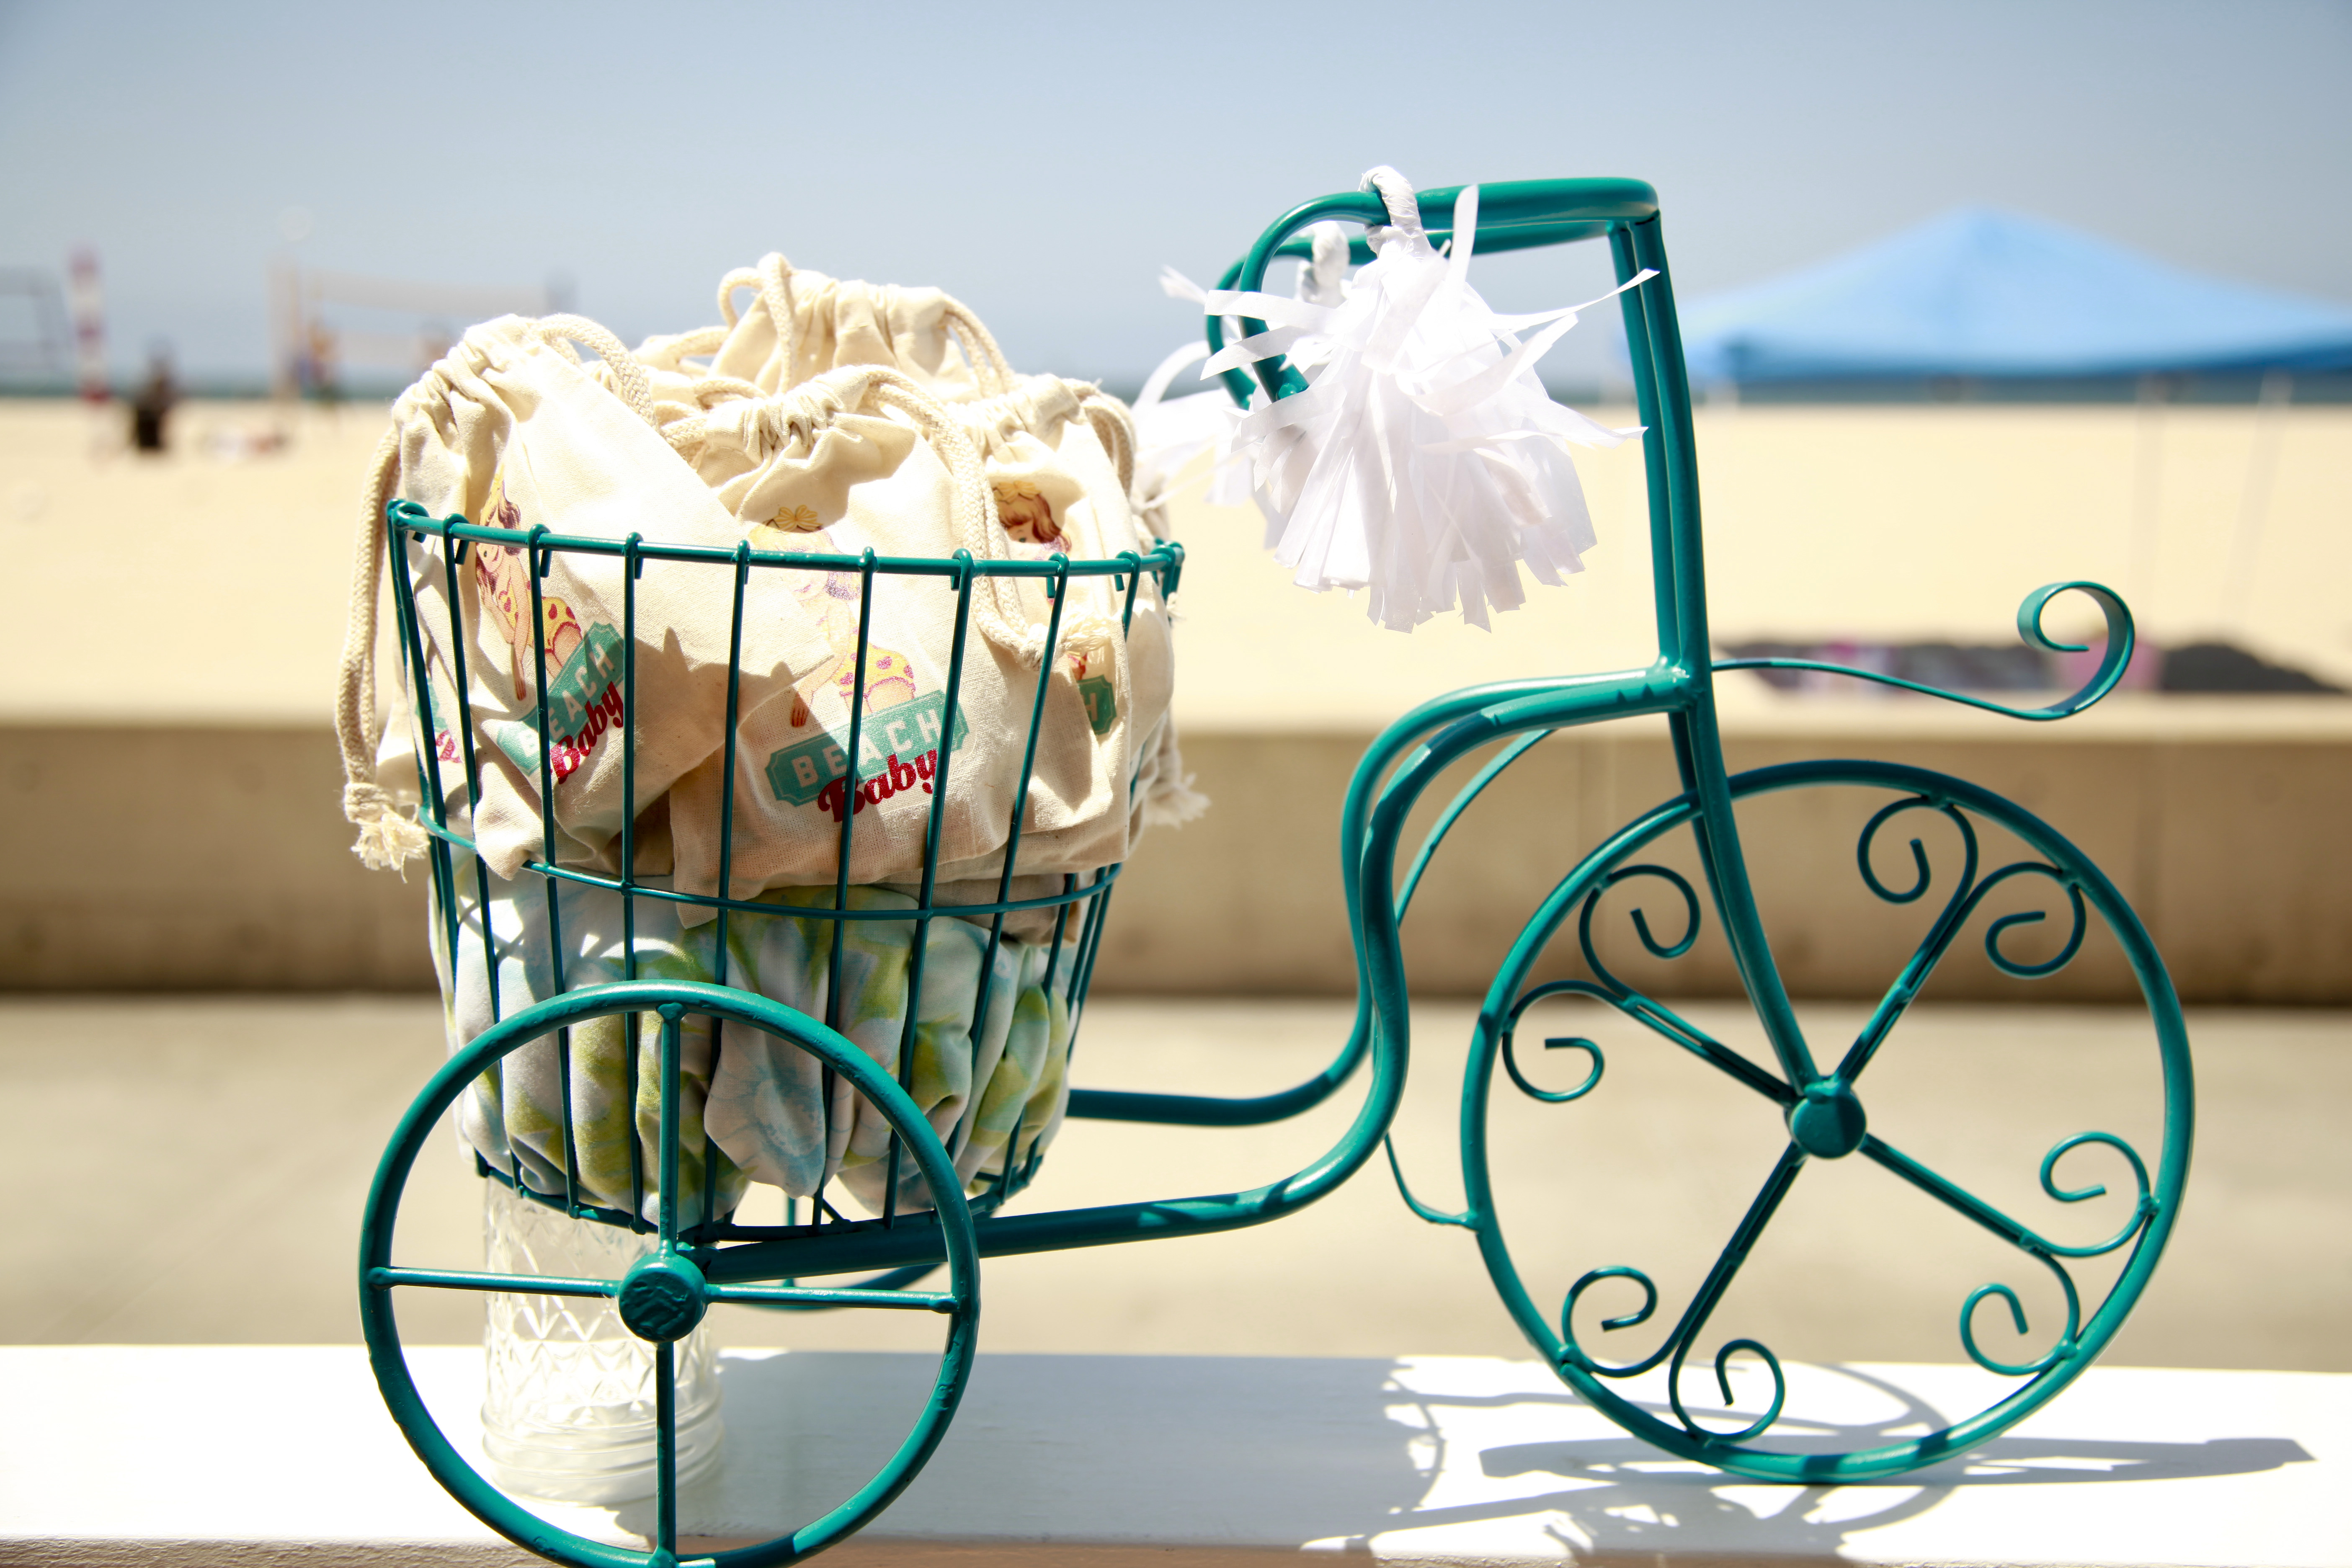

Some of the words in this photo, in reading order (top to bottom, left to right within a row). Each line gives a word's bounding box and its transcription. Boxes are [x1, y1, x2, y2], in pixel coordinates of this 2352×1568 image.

[510, 642, 614, 757] BEACH
[549, 681, 624, 785] Baby
[792, 709, 942, 788] BEACH
[818, 748, 939, 823] Baby
